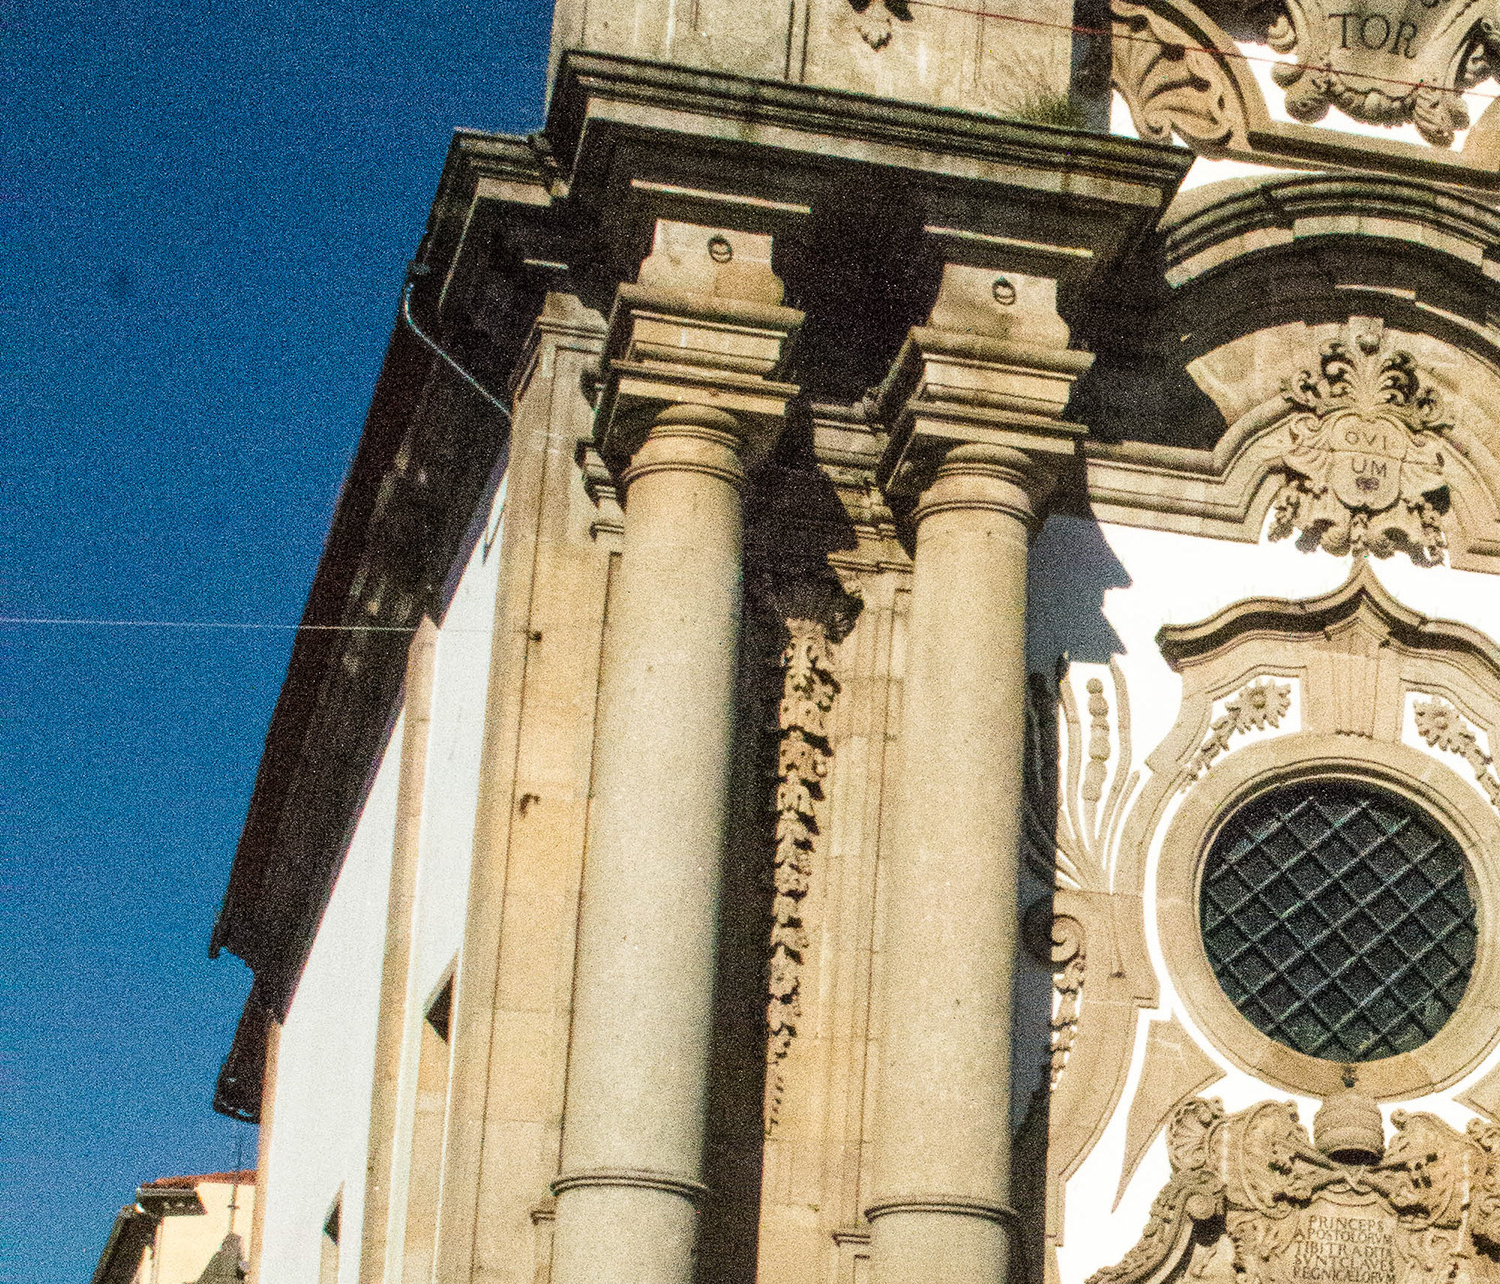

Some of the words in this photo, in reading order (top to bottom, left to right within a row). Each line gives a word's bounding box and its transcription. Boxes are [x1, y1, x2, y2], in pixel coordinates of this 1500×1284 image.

[1328, 11, 1419, 59] TOR
[1344, 431, 1387, 451] OVI
[1350, 457, 1387, 478] UM
[1308, 1215, 1384, 1233] PRINCEPS
[1293, 1228, 1393, 1246] APOSTOLORVM
[1340, 1257, 1396, 1273] CLAVES
